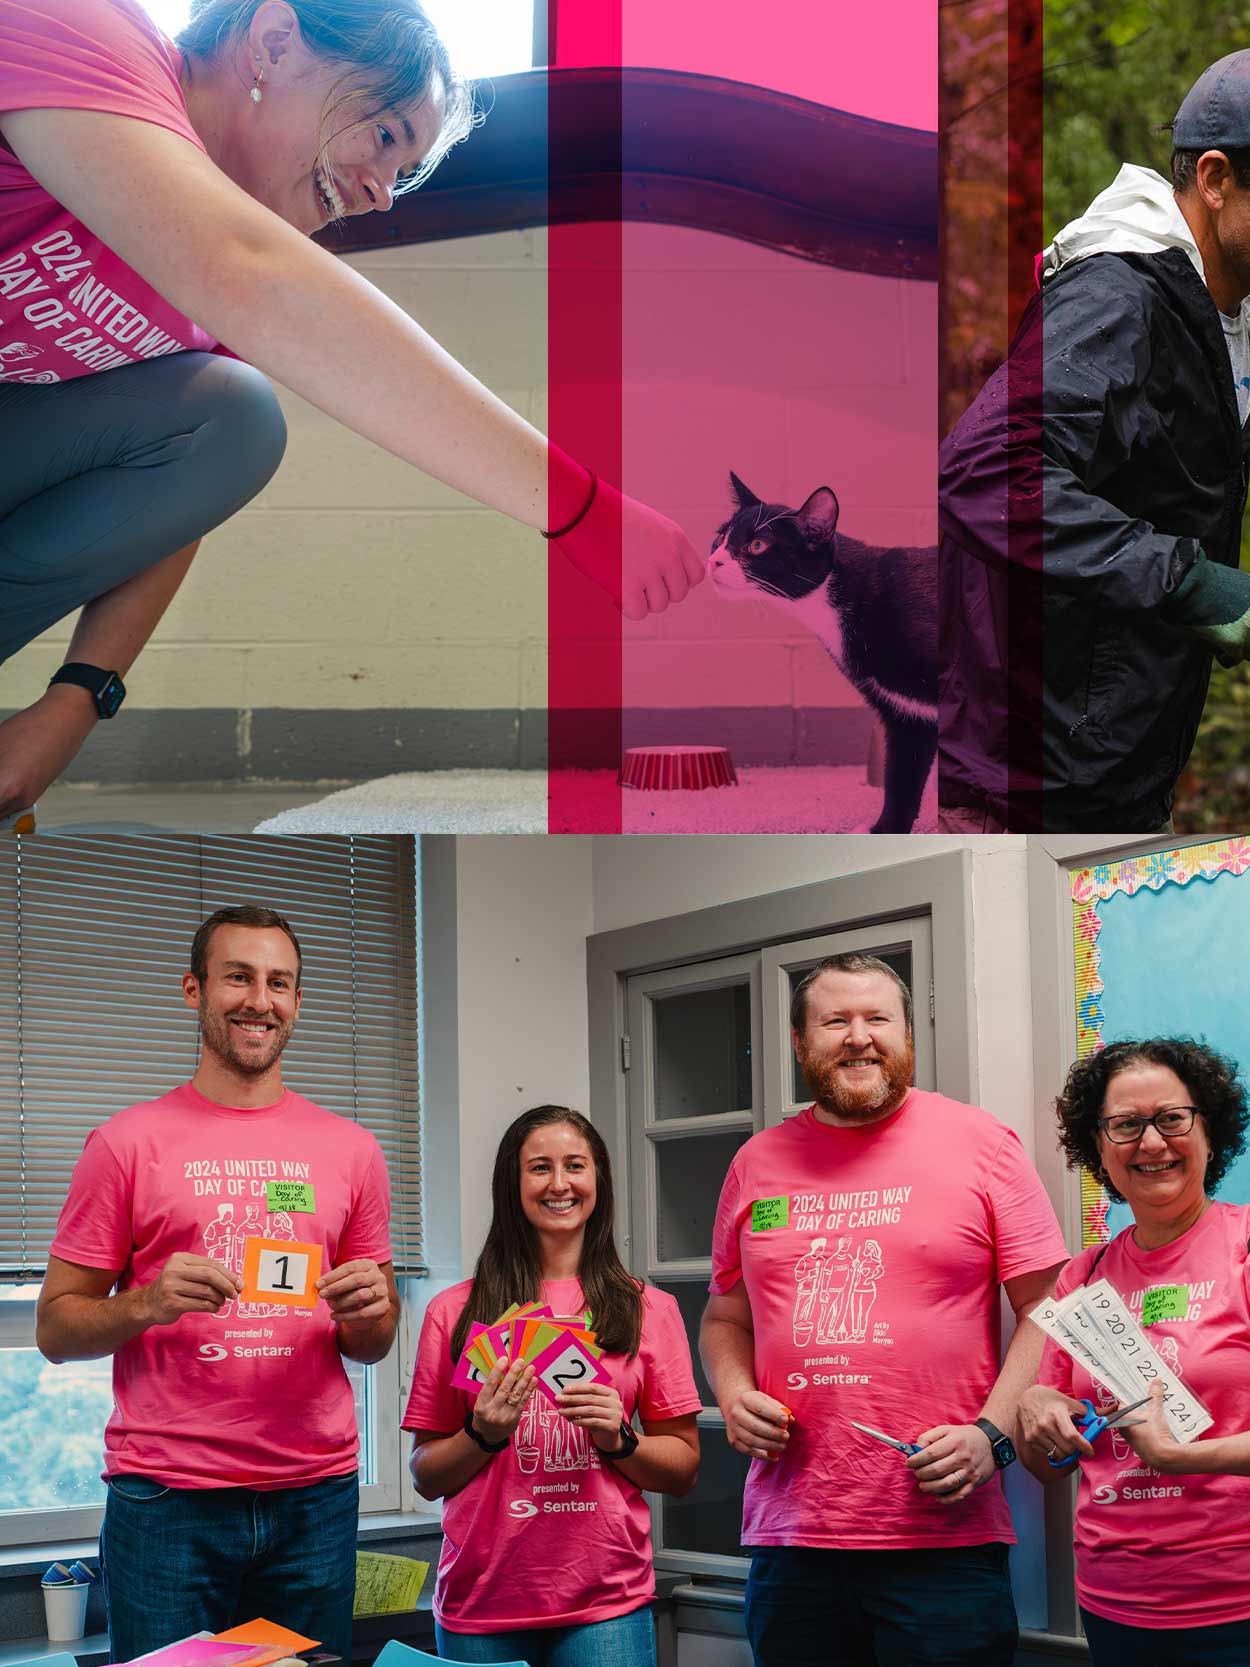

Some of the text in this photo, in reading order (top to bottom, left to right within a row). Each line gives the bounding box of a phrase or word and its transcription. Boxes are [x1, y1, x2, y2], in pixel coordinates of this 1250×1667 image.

[31, 230, 93, 283] 024
[132, 326, 187, 359] WAY
[0, 252, 136, 371] DAY OF CARIN
[183, 1159, 310, 1179] 2024 UNITED WAY
[194, 1179, 222, 1197] DAY
[227, 1179, 247, 1196] OF
[793, 1186, 912, 1214] 2024 UNITED WAY
[795, 1207, 901, 1232] DAY OF CARING
[271, 1255, 294, 1290] 1
[224, 1328, 274, 1341] presented by
[233, 1345, 293, 1358] Sentara
[804, 1354, 850, 1368] presented by
[1091, 1292, 1110, 1309] 19
[1105, 1314, 1126, 1335] 20
[1120, 1337, 1141, 1356] 21
[1136, 1360, 1158, 1382] 22
[1170, 1402, 1191, 1423] 24
[552, 1359, 587, 1390] 2
[812, 1373, 869, 1386] Sentara
[532, 1482, 580, 1496] presented by
[1122, 1486, 1183, 1500] Sentara
[543, 1500, 596, 1513] Sentara
